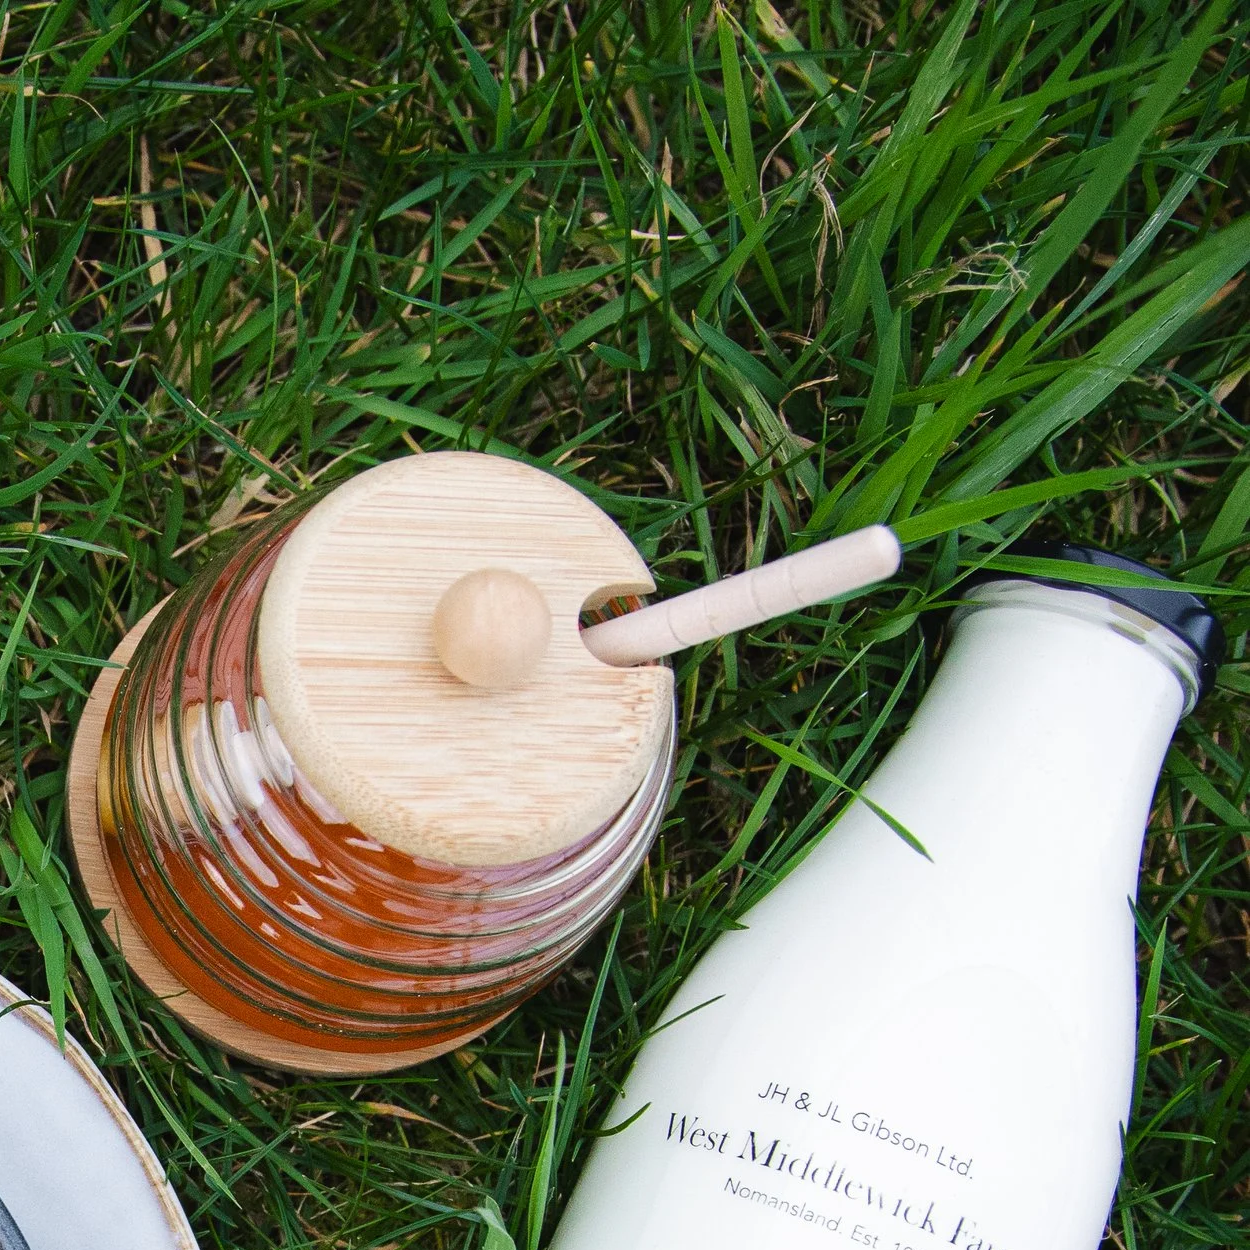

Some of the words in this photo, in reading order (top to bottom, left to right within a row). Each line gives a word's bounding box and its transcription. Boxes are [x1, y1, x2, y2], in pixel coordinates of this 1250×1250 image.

[665, 1112, 730, 1154] West
[758, 1081, 790, 1104] JH
[795, 1092, 811, 1112] &
[818, 1101, 842, 1124] JL
[851, 1112, 929, 1157] Gibson
[936, 1146, 974, 1180] Ltd.
[851, 1224, 880, 1250] Est
